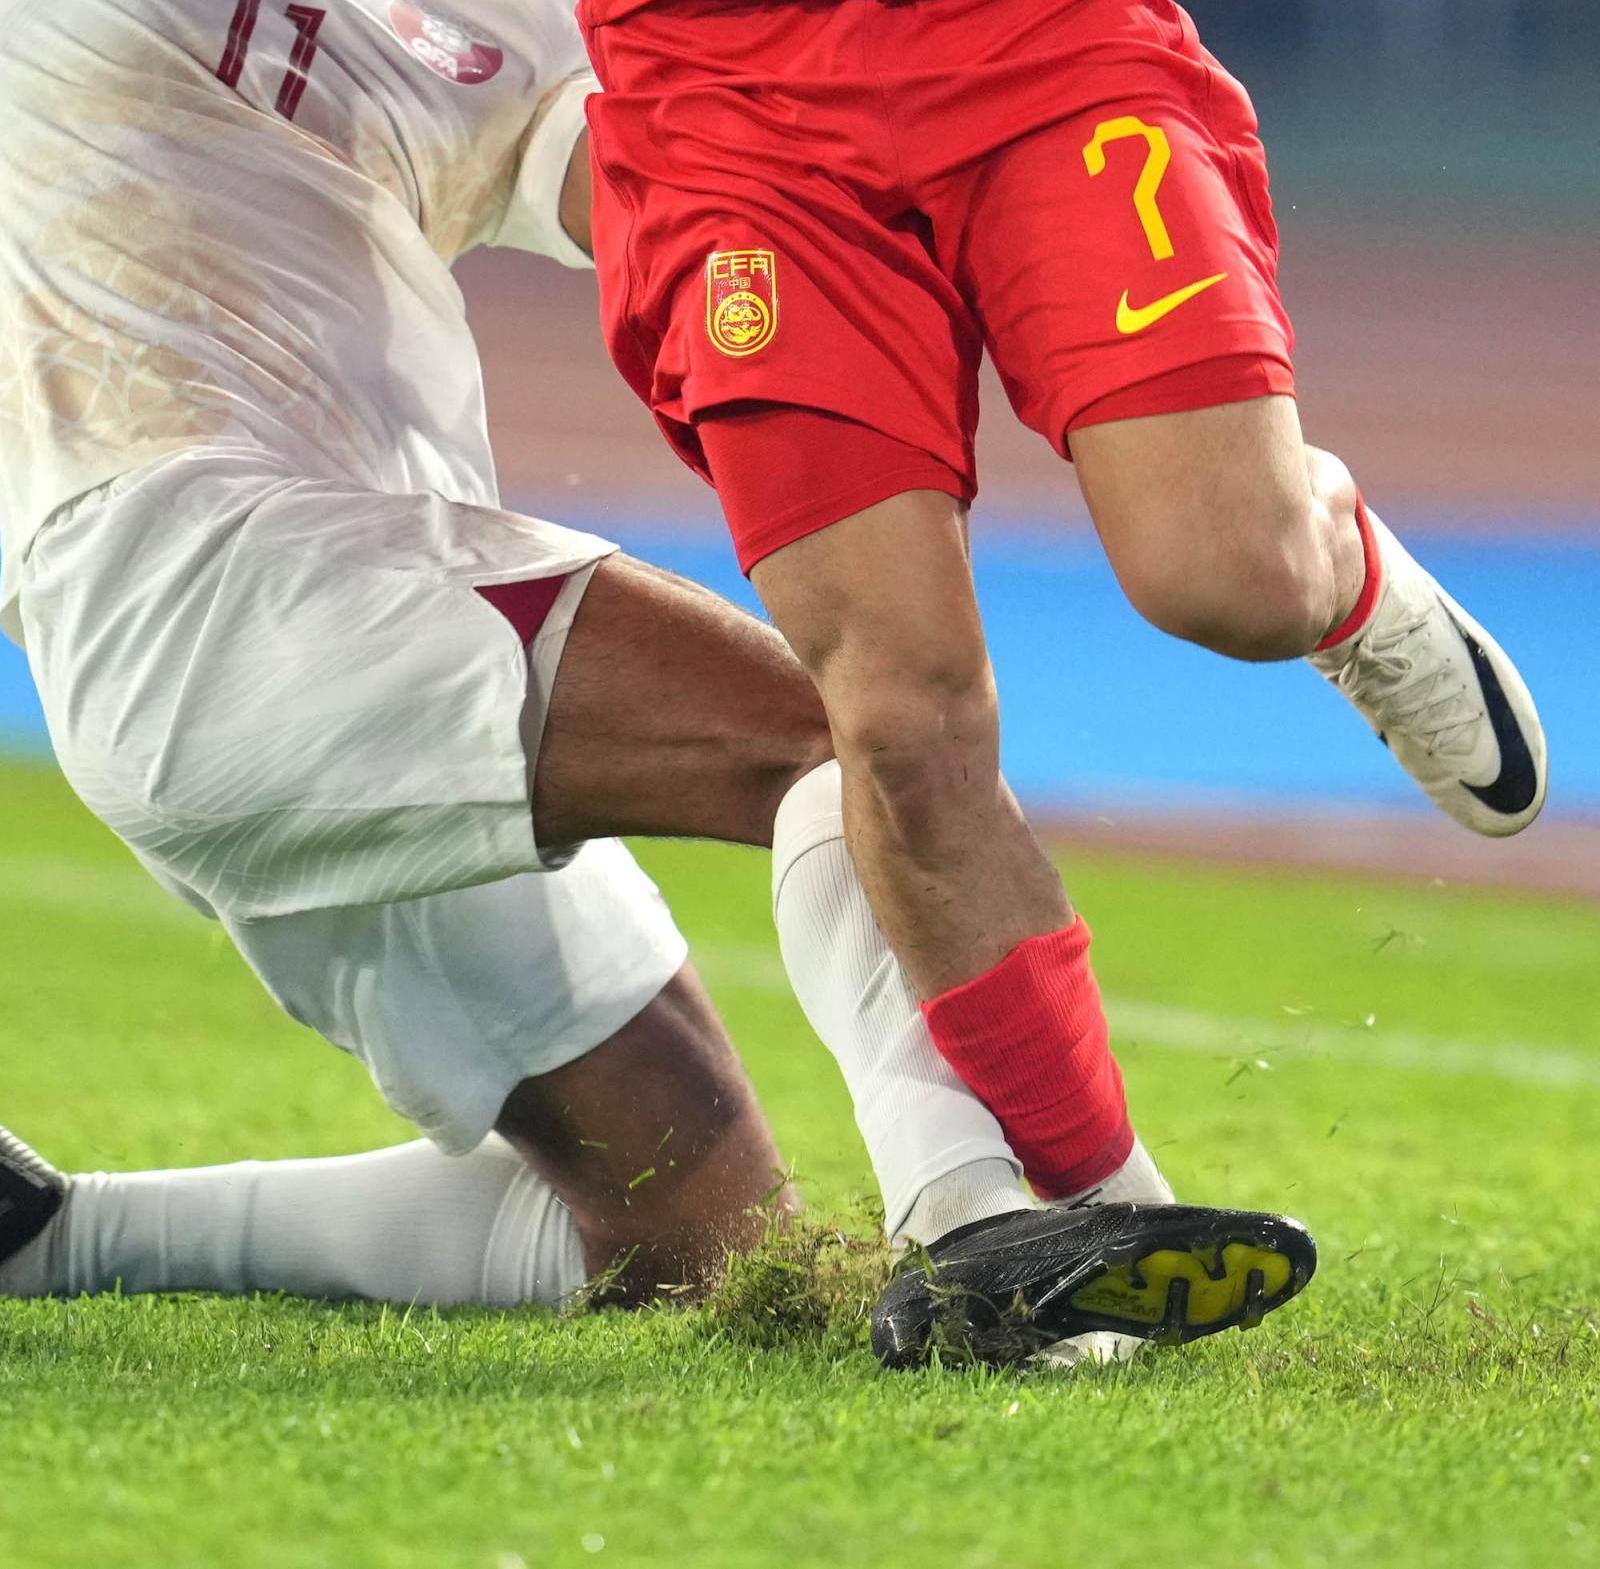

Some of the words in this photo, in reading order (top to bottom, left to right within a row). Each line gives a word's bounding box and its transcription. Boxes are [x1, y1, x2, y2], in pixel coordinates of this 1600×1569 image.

[411, 37, 458, 79] QFA
[1081, 115, 1175, 262] 7
[713, 257, 769, 279] CFA
[728, 276, 751, 289] 中国
